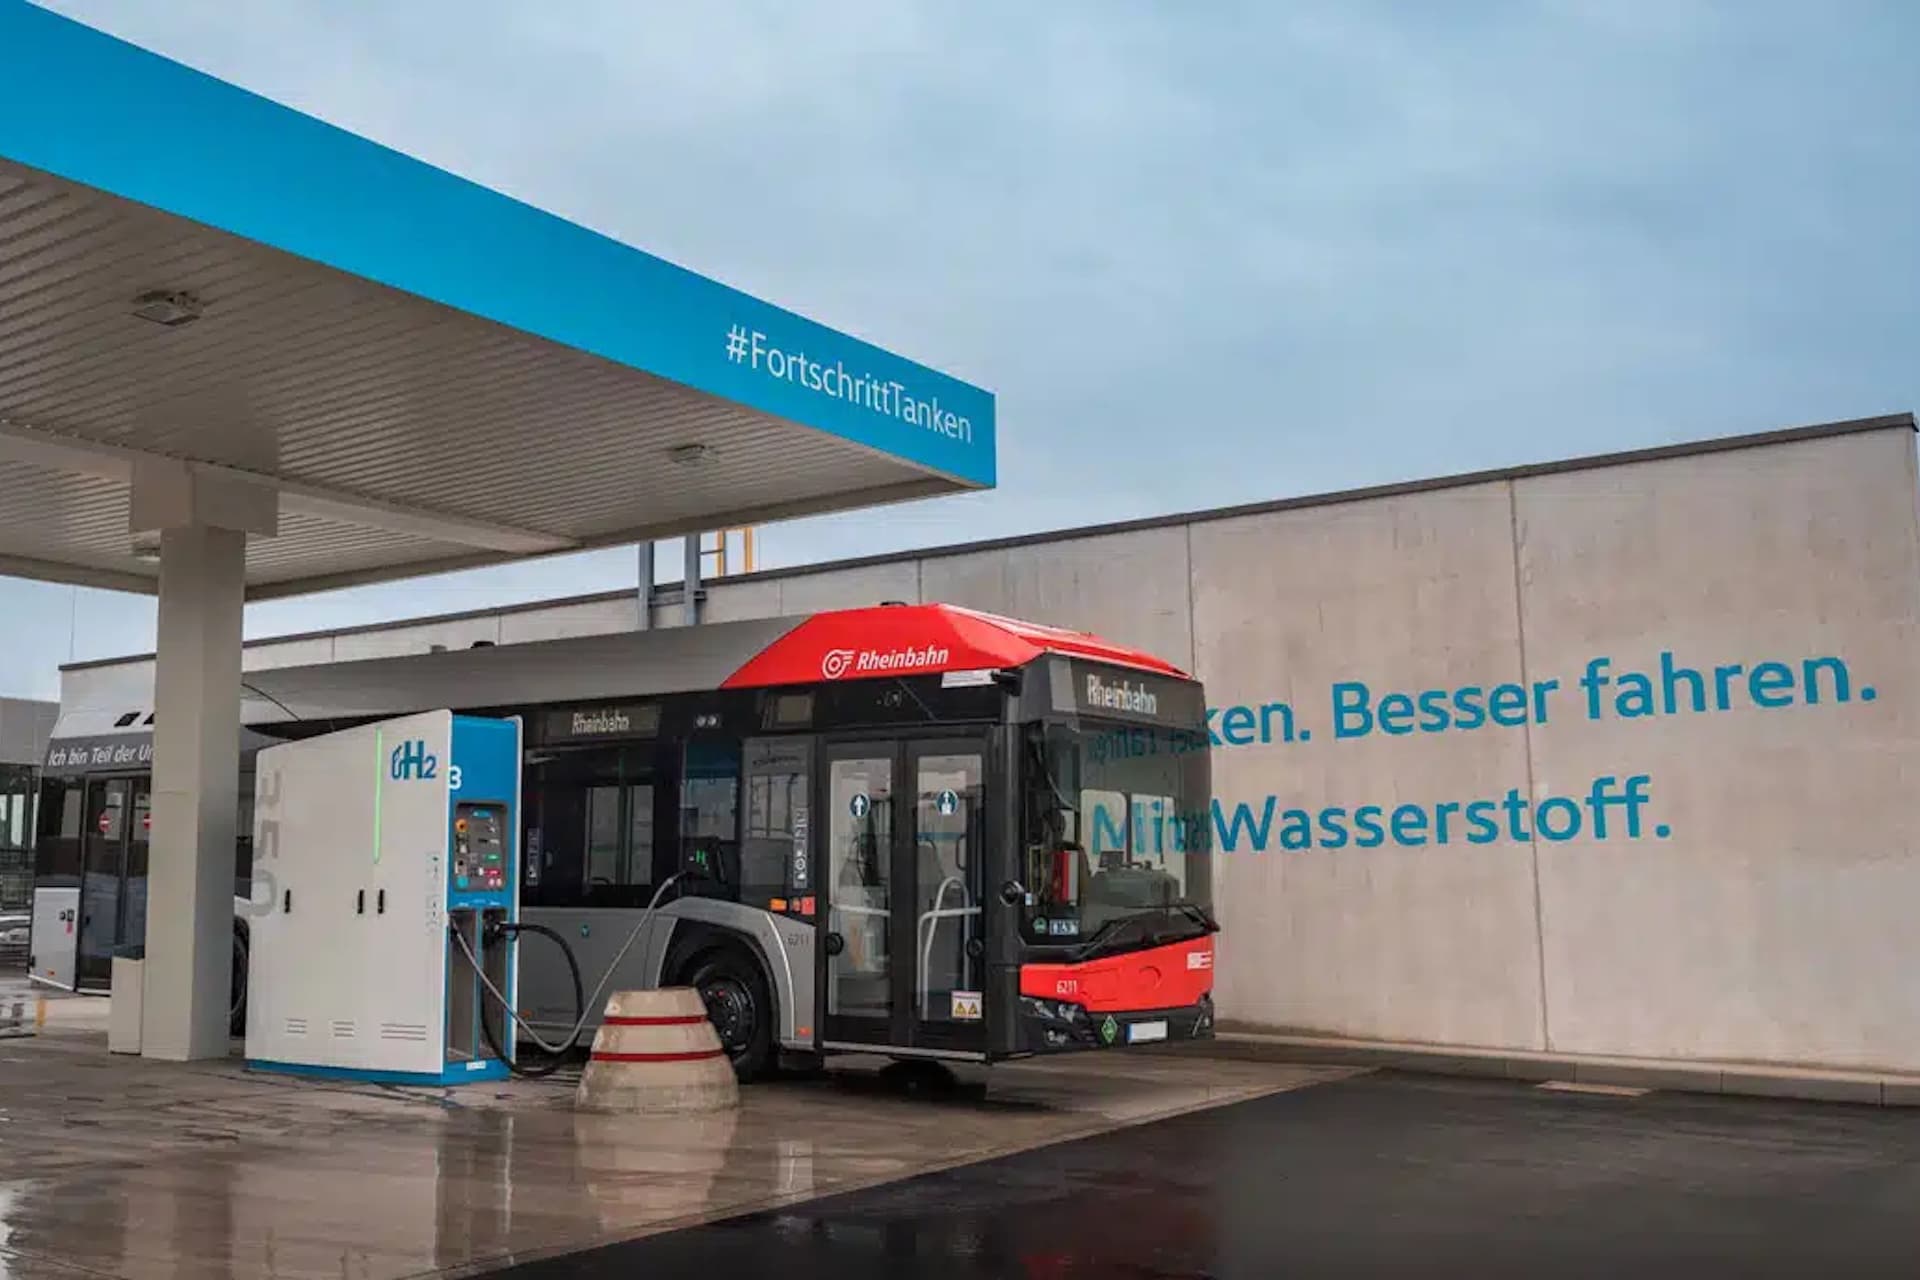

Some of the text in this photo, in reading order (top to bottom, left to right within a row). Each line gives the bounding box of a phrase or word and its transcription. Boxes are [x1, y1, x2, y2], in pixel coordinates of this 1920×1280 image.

[726, 323, 971, 443] #FortschrittTanken
[857, 644, 949, 670] Rheinbahn
[1087, 674, 1157, 714] Rheinbahn
[1332, 680, 1559, 739] Besser
[1579, 651, 1877, 719] fahren.
[572, 710, 630, 735] Rheinbahn
[48, 747, 66, 766] Ich
[68, 747, 88, 765] bin
[91, 745, 114, 764] Teil
[115, 744, 136, 762] der
[447, 765, 463, 790] 3
[1211, 774, 1671, 853] Wasserstoff.
